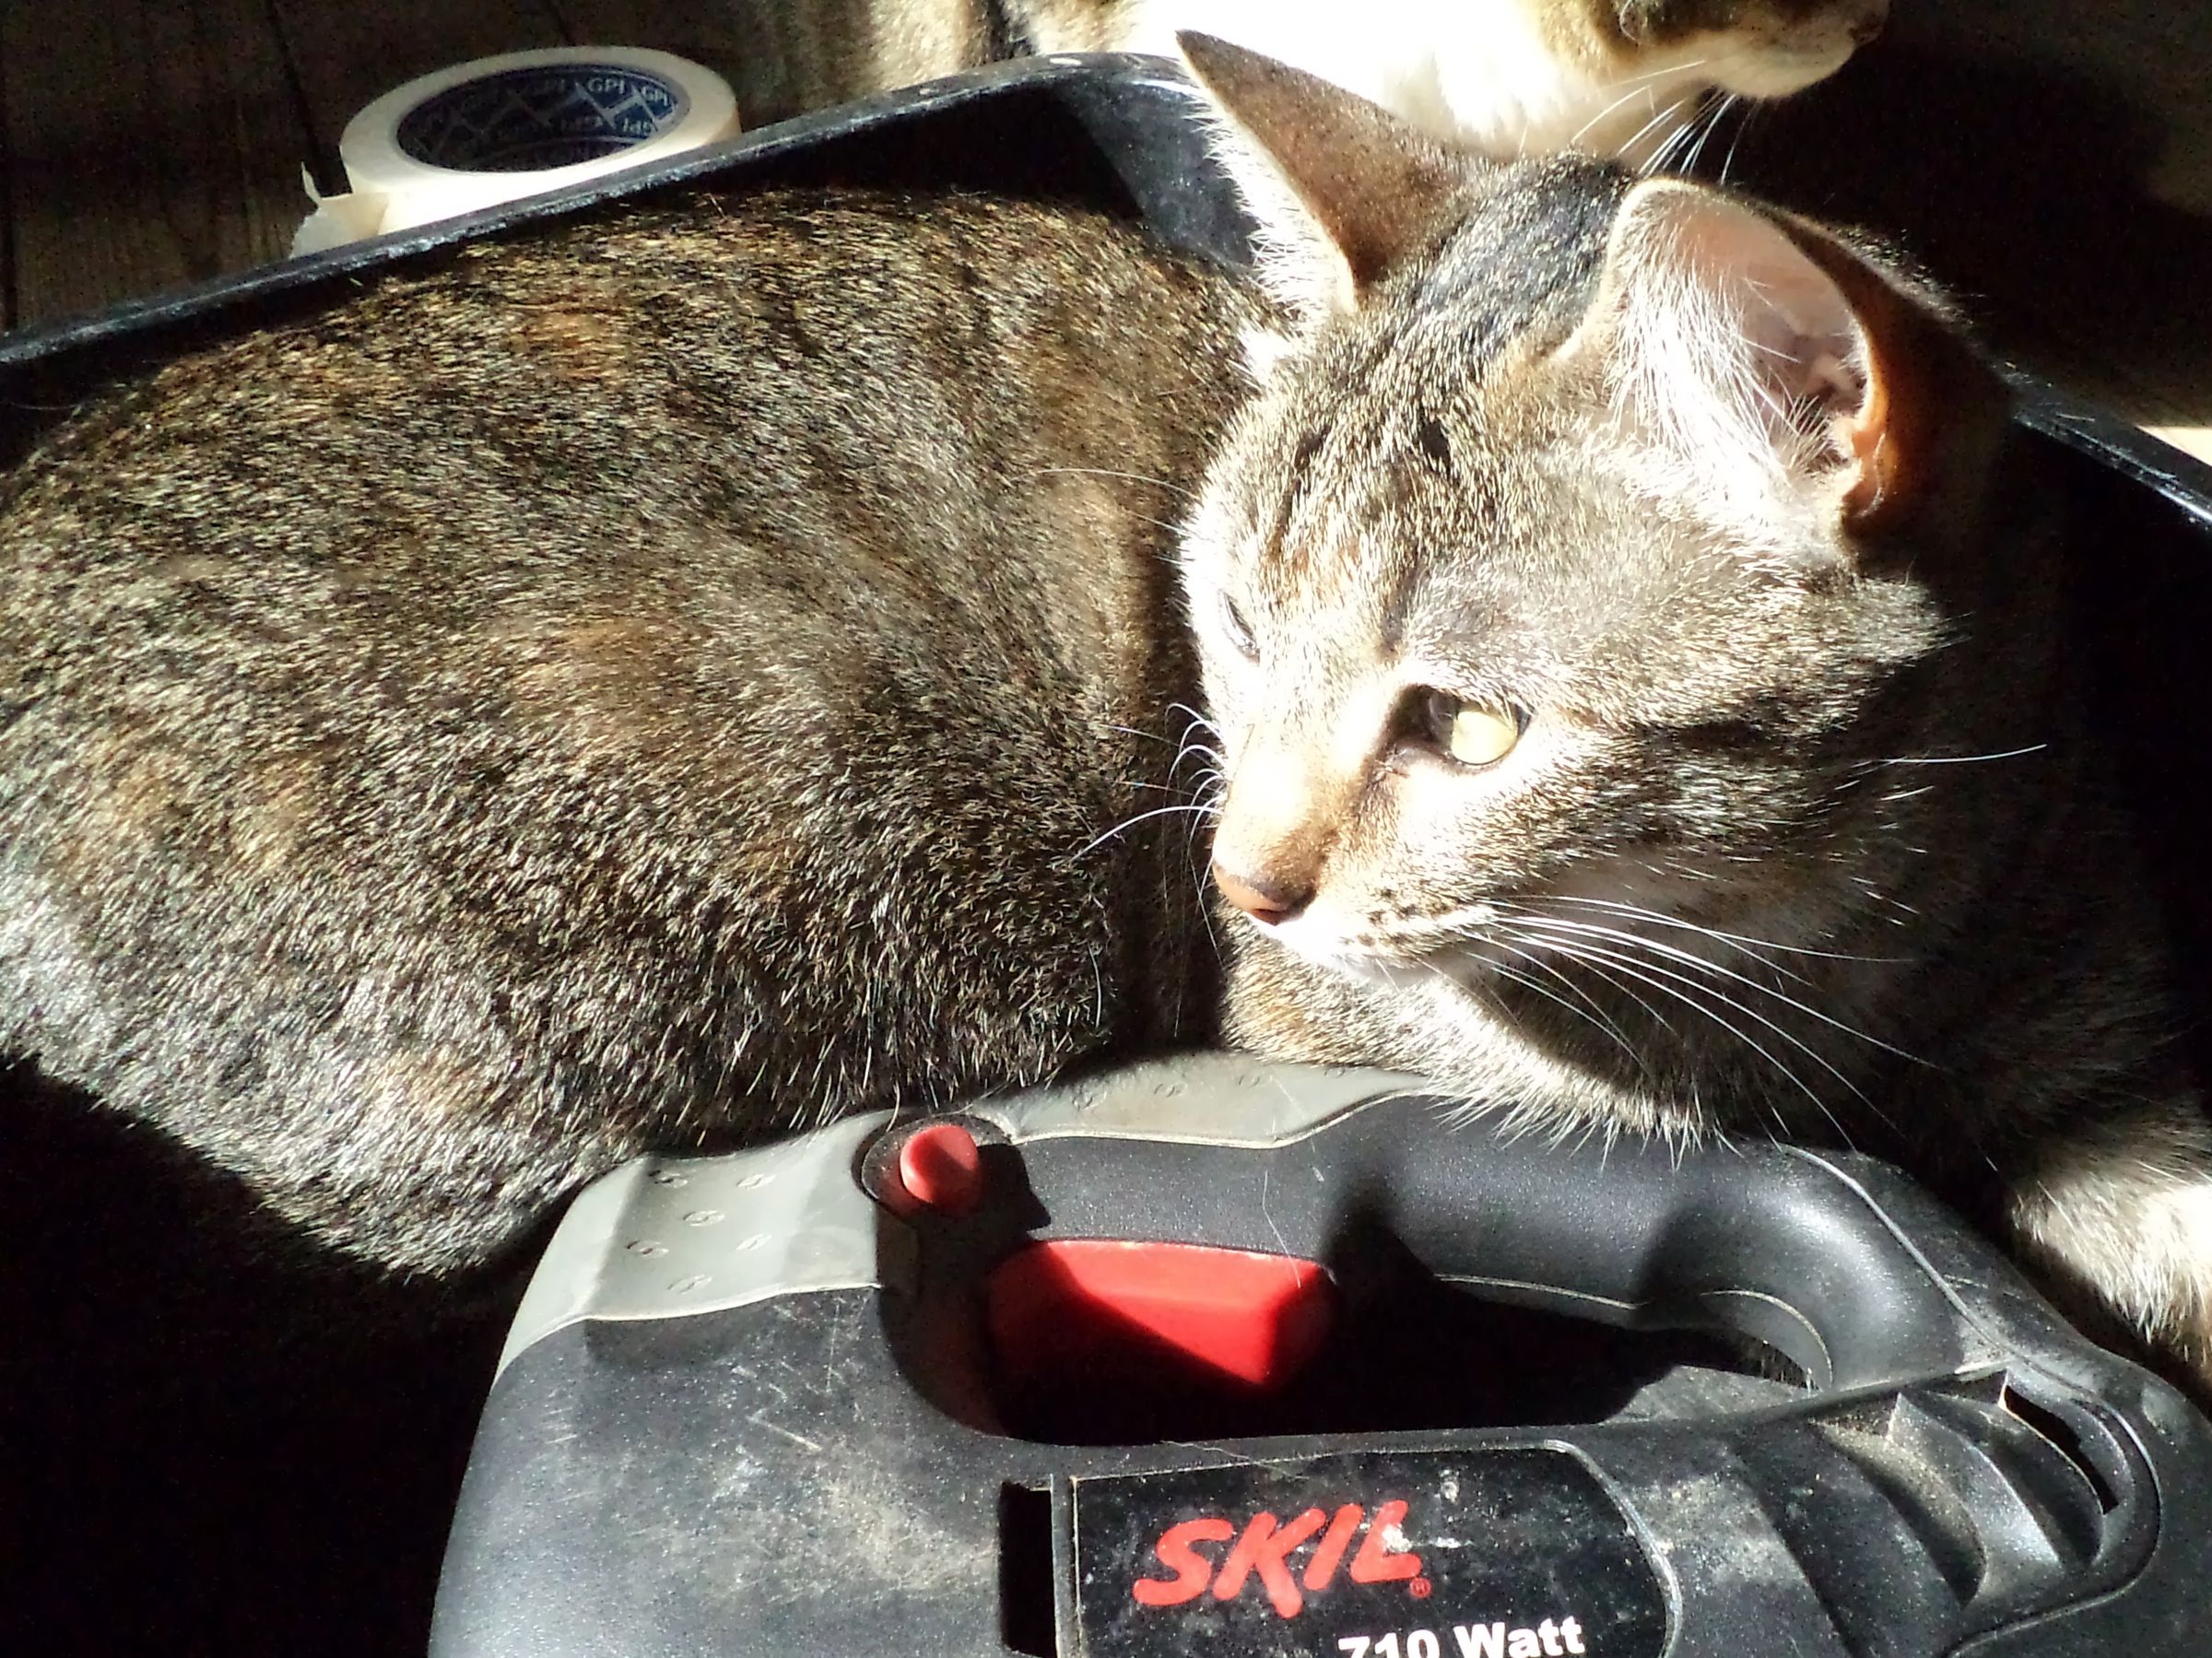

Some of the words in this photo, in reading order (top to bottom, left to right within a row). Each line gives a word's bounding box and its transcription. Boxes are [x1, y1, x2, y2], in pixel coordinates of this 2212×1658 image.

[588, 77, 625, 94] GPI
[1133, 1499, 1422, 1618] SKIL
[1338, 1629, 1440, 1658] 710
[1453, 1616, 1585, 1658] Watt
